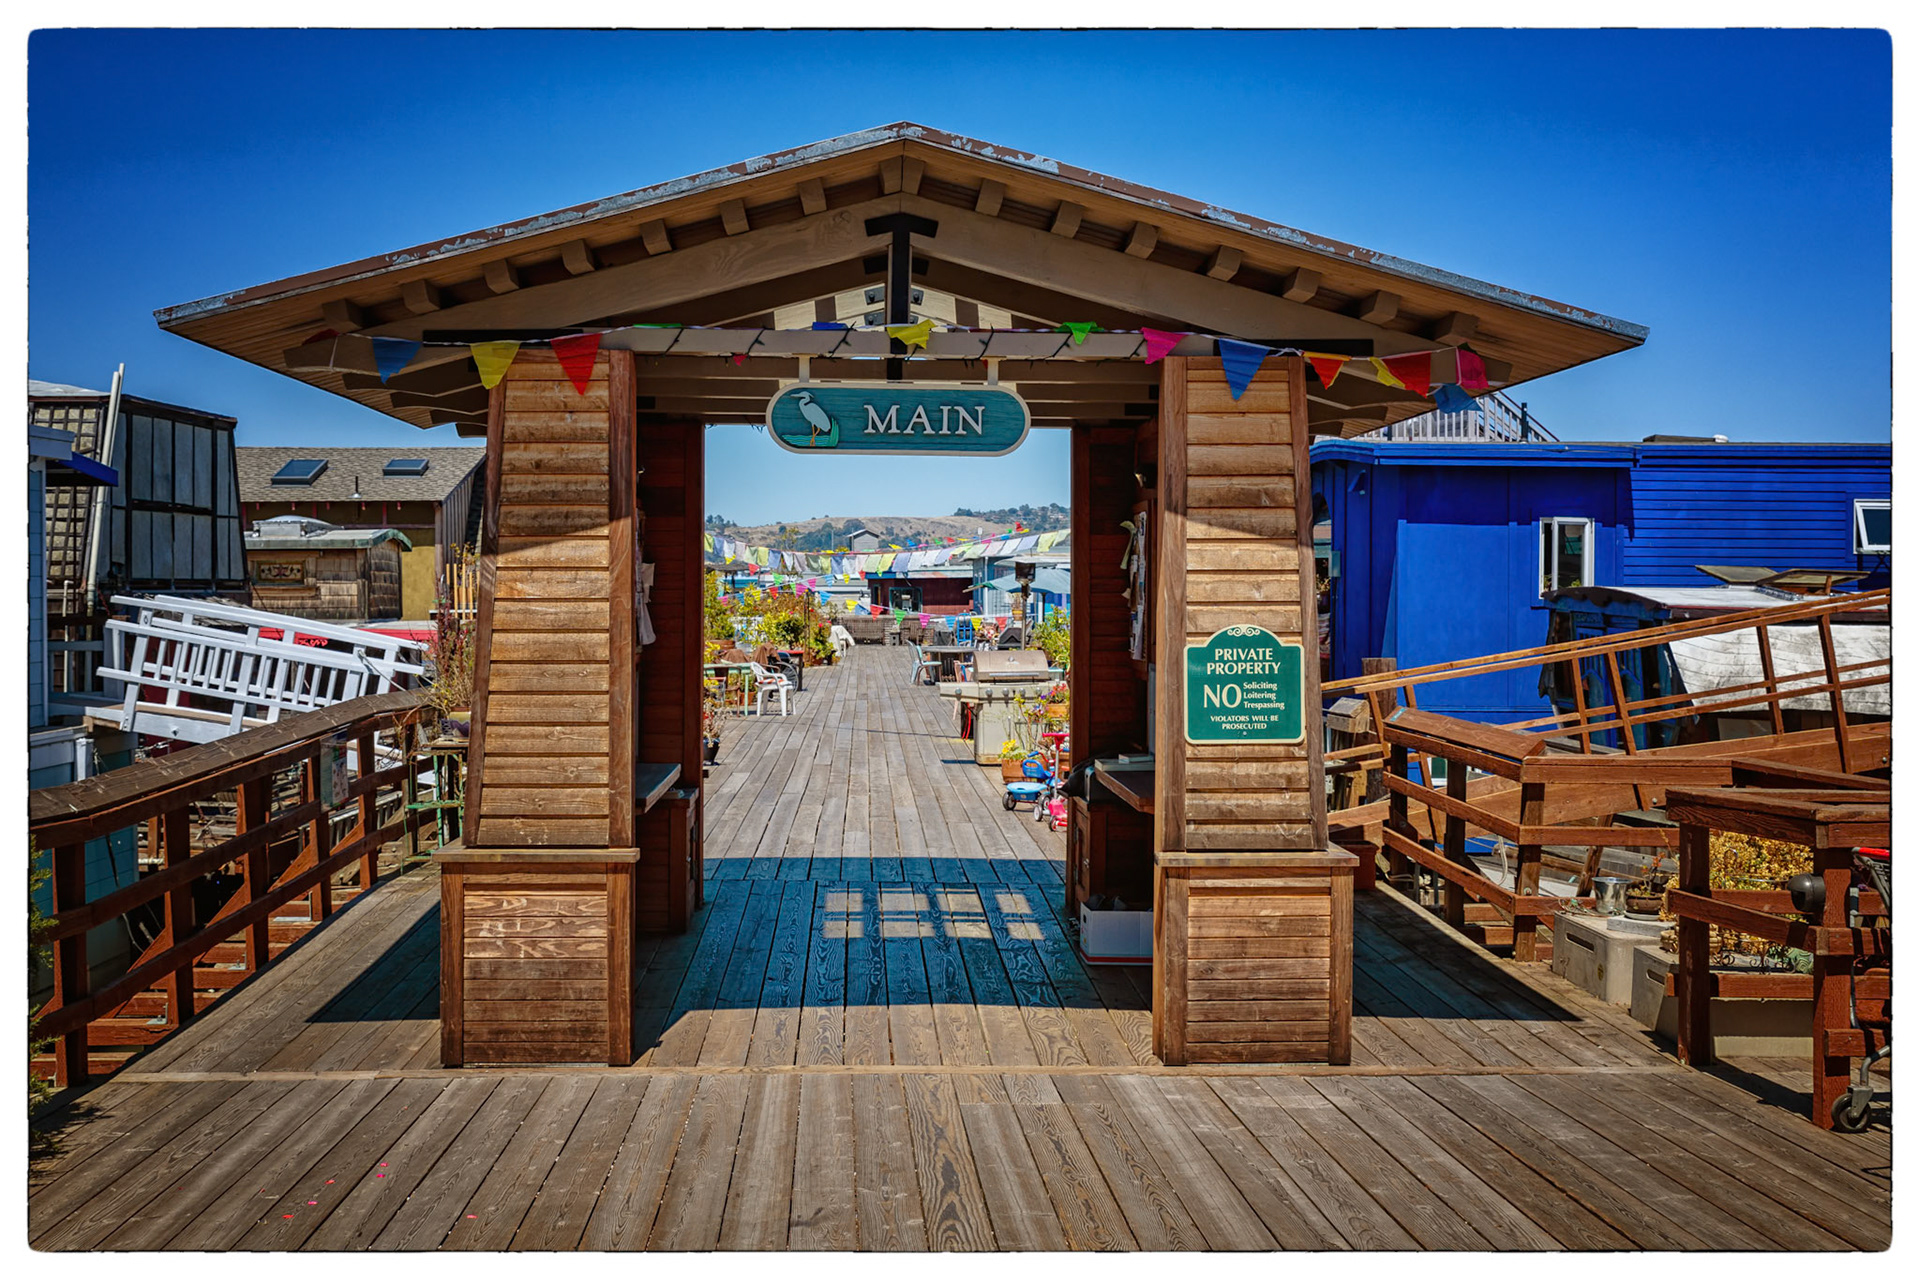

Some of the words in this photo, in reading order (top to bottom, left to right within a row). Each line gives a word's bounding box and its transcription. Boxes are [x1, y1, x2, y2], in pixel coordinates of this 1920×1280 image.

[863, 404, 986, 436] MAIN
[1214, 648, 1273, 660] PRIVATE
[1207, 662, 1281, 675] PROPERTY
[1243, 682, 1278, 691] Soliciting
[1204, 684, 1242, 708] NO
[1243, 691, 1276, 700] Loitering
[1244, 701, 1285, 710] Trespassing
